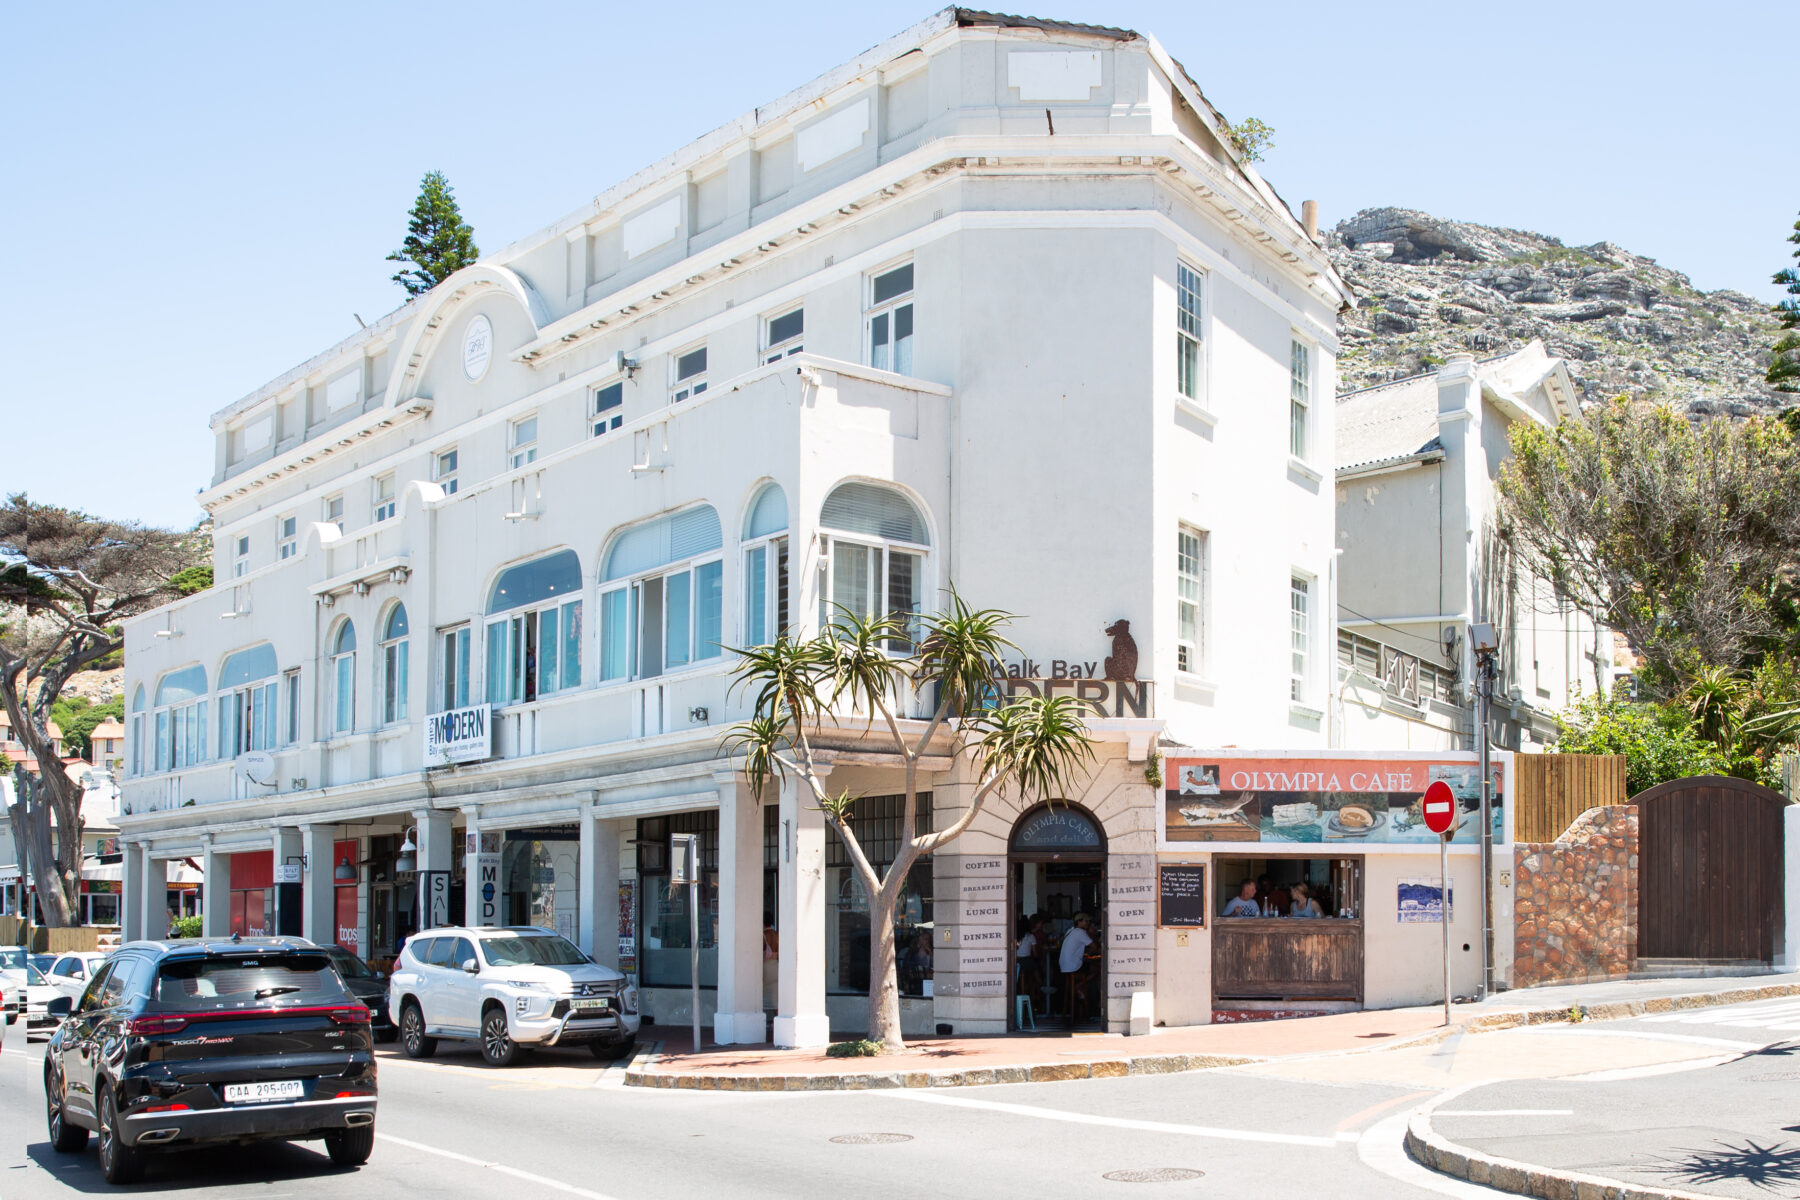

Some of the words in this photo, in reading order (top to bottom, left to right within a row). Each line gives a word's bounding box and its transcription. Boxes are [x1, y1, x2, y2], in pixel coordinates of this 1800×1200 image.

[990, 659, 1041, 679] Kalk
[1051, 659, 1098, 679] Bay
[434, 708, 484, 744] MODERN
[1230, 771, 1342, 791] OLYMPIA
[1350, 767, 1414, 791] CAFÉ
[1022, 815, 1066, 842] OLYMPIA
[1036, 834, 1057, 843] and
[965, 860, 1001, 870] COFFEE
[1120, 861, 1142, 870] TEA
[963, 884, 1005, 893] BREAKFAST
[1111, 885, 1153, 895] BAKERY
[966, 908, 999, 917] LUNCH
[1119, 909, 1145, 918] OPEN
[339, 924, 358, 944] tops
[963, 932, 1002, 941] DINNER
[1115, 933, 1147, 942] DAILY
[963, 980, 1002, 988] MUSSELS
[1114, 980, 1146, 989] CAKES
[229, 1086, 250, 1098] CAA
[256, 1082, 299, 1096] 295-097
